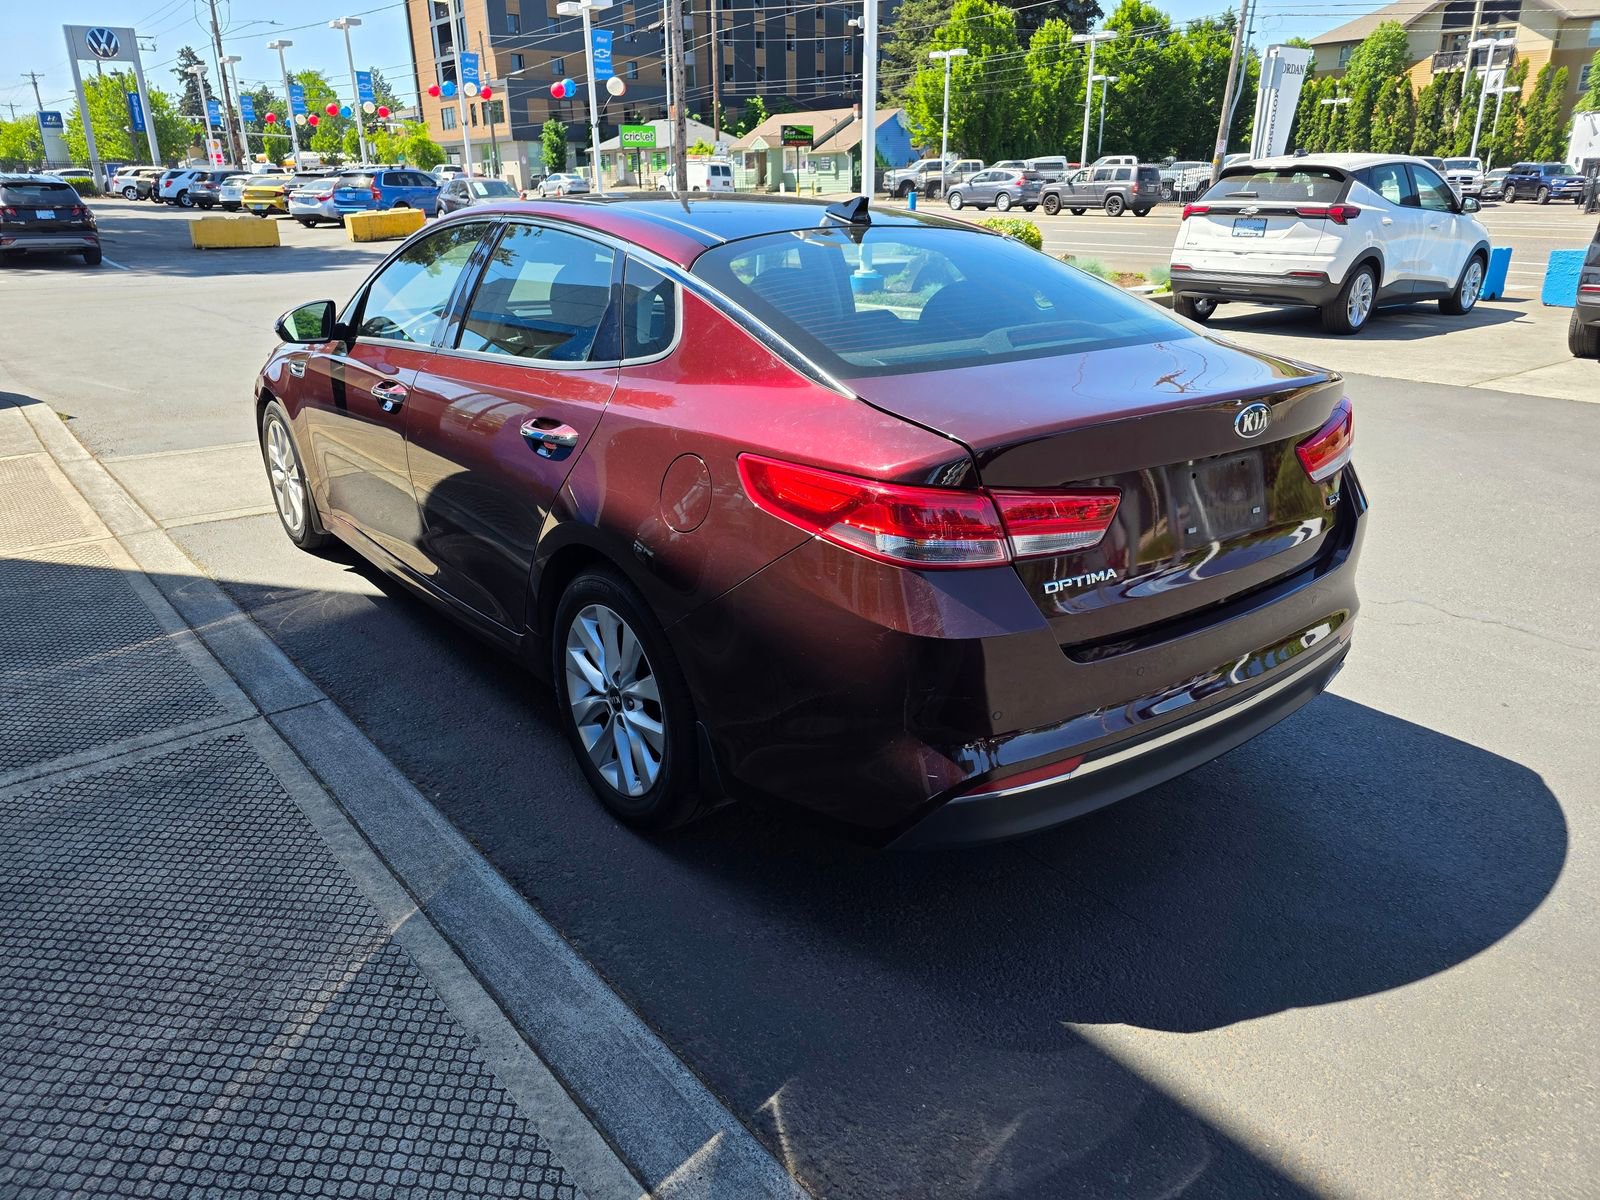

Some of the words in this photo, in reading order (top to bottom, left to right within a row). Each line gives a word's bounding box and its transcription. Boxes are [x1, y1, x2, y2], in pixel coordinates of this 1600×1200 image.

[87, 27, 119, 57] VW
[623, 131, 655, 141] cricket
[1242, 409, 1268, 433] KIA
[1329, 492, 1341, 505] EX
[1043, 568, 1118, 595] OPTIMA
